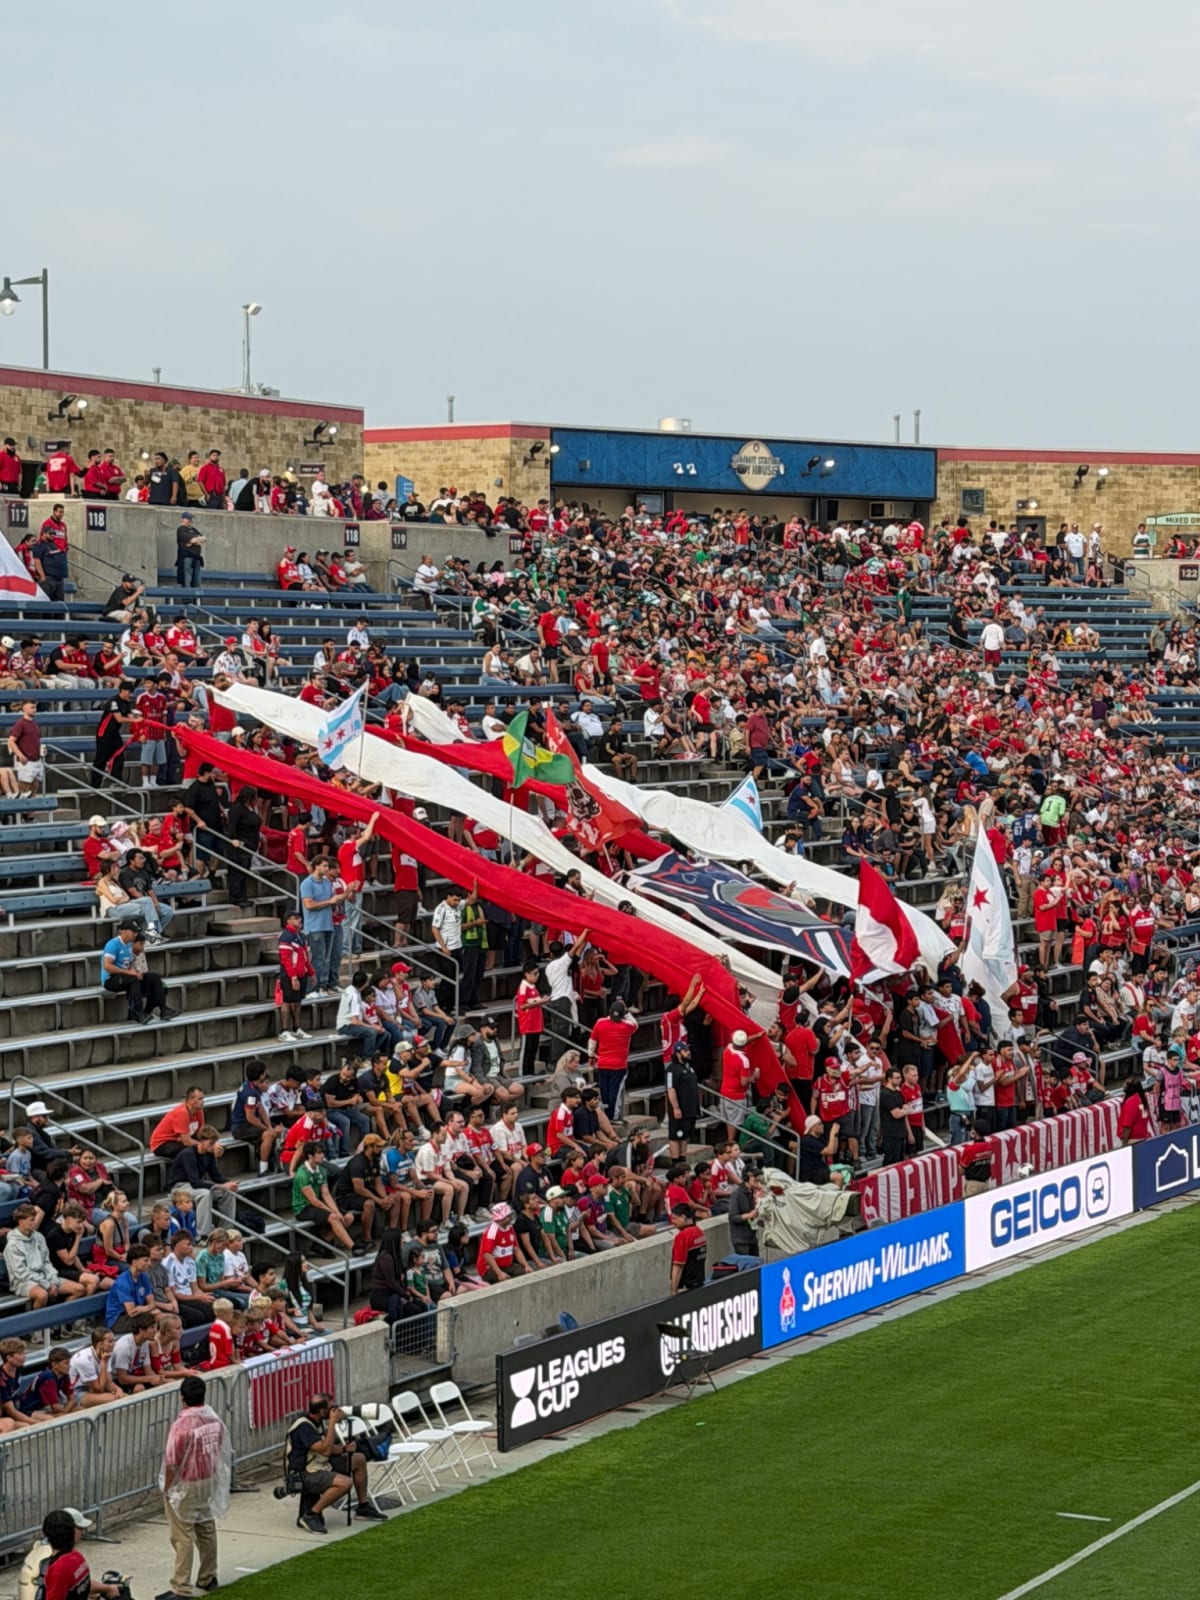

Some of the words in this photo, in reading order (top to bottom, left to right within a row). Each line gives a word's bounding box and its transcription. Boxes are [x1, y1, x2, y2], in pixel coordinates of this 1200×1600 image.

[10, 508, 27, 523] 117
[88, 512, 105, 527] 118
[345, 529, 359, 543] 118
[1181, 568, 1198, 578] 122
[990, 1175, 1081, 1248] GEICO
[537, 1336, 626, 1392] LEAGUES
[537, 1379, 580, 1418] CUP
